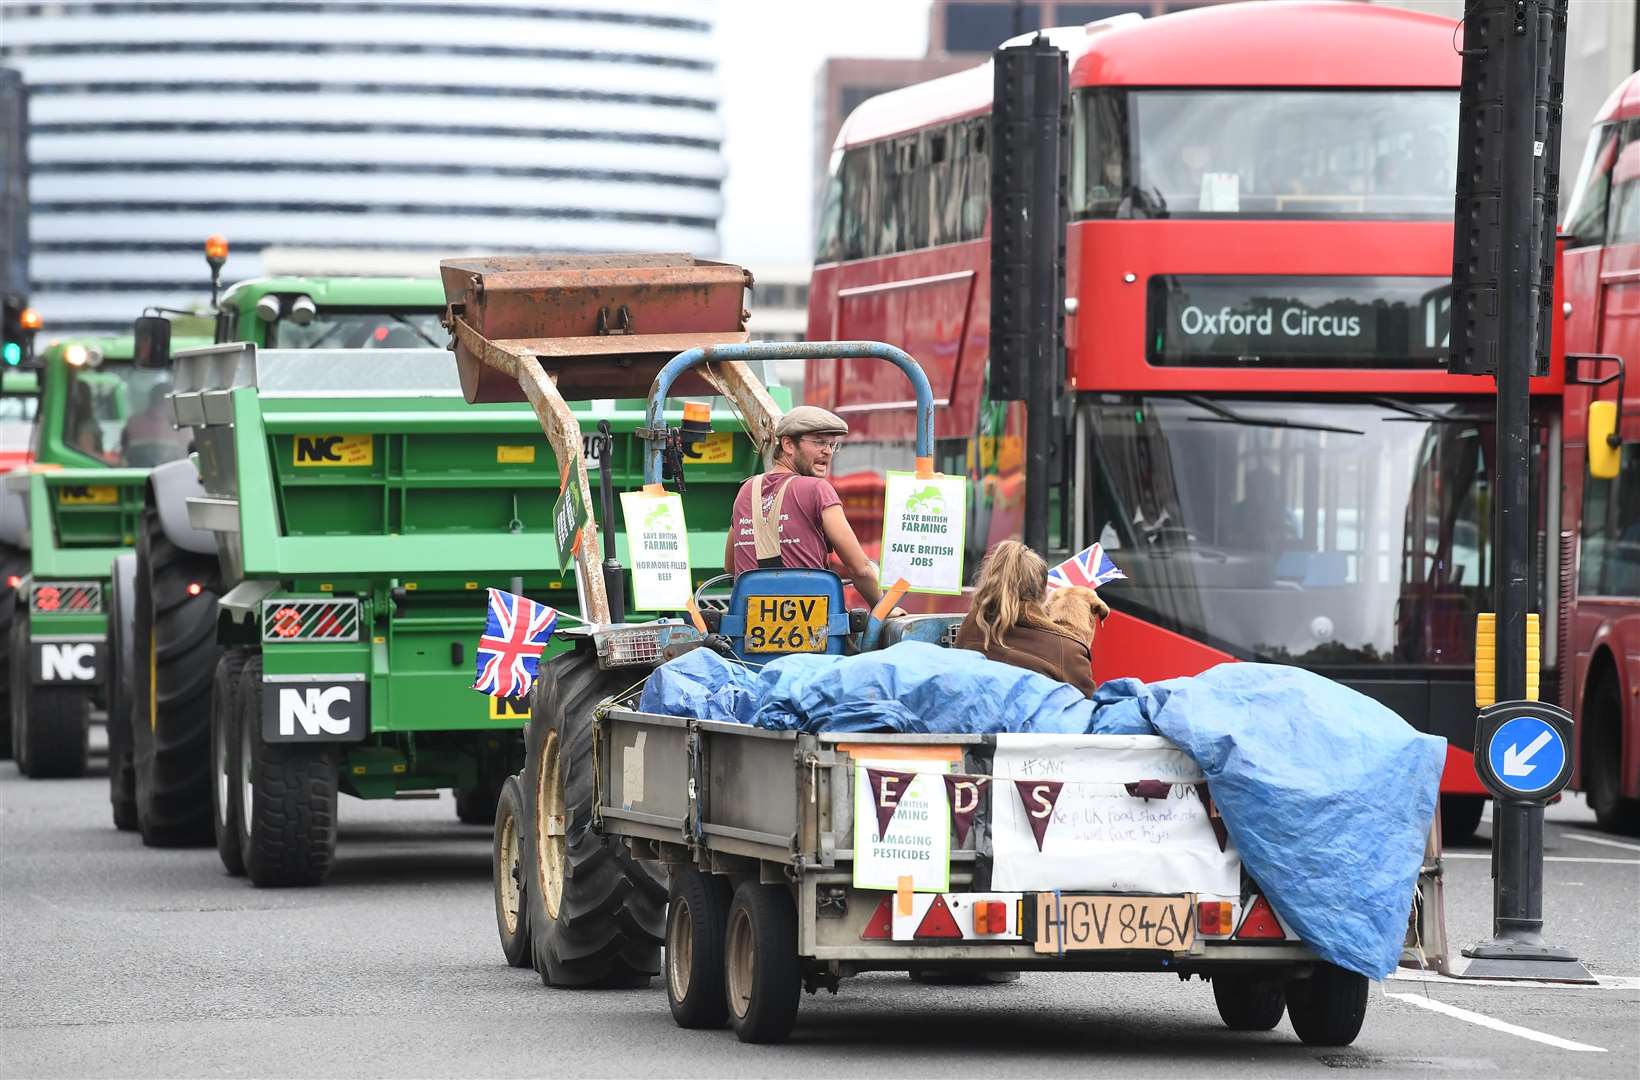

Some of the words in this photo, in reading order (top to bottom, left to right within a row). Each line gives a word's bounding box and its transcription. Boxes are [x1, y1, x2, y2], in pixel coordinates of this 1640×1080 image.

[1181, 306, 1272, 335] Oxford
[1281, 308, 1361, 336] Circus
[297, 436, 344, 461] NC
[902, 513, 920, 522] SAVE
[921, 514, 948, 523] BRITISH
[901, 521, 948, 534] FARMING
[643, 532, 657, 540] SAVE
[658, 532, 678, 540] BRITISH
[644, 540, 678, 551] FARMING
[891, 543, 915, 554] SAVE
[918, 544, 954, 556] BRITISH
[636, 561, 687, 570] HORMONE-FILLED
[910, 556, 934, 567] JOBS
[657, 573, 672, 581] BEEF
[760, 599, 816, 622] HGV
[41, 644, 96, 680] NC
[280, 686, 351, 735] NC
[873, 847, 930, 860] PESTICIDES
[1045, 901, 1112, 945] HGV
[1119, 903, 1194, 946] 846V
